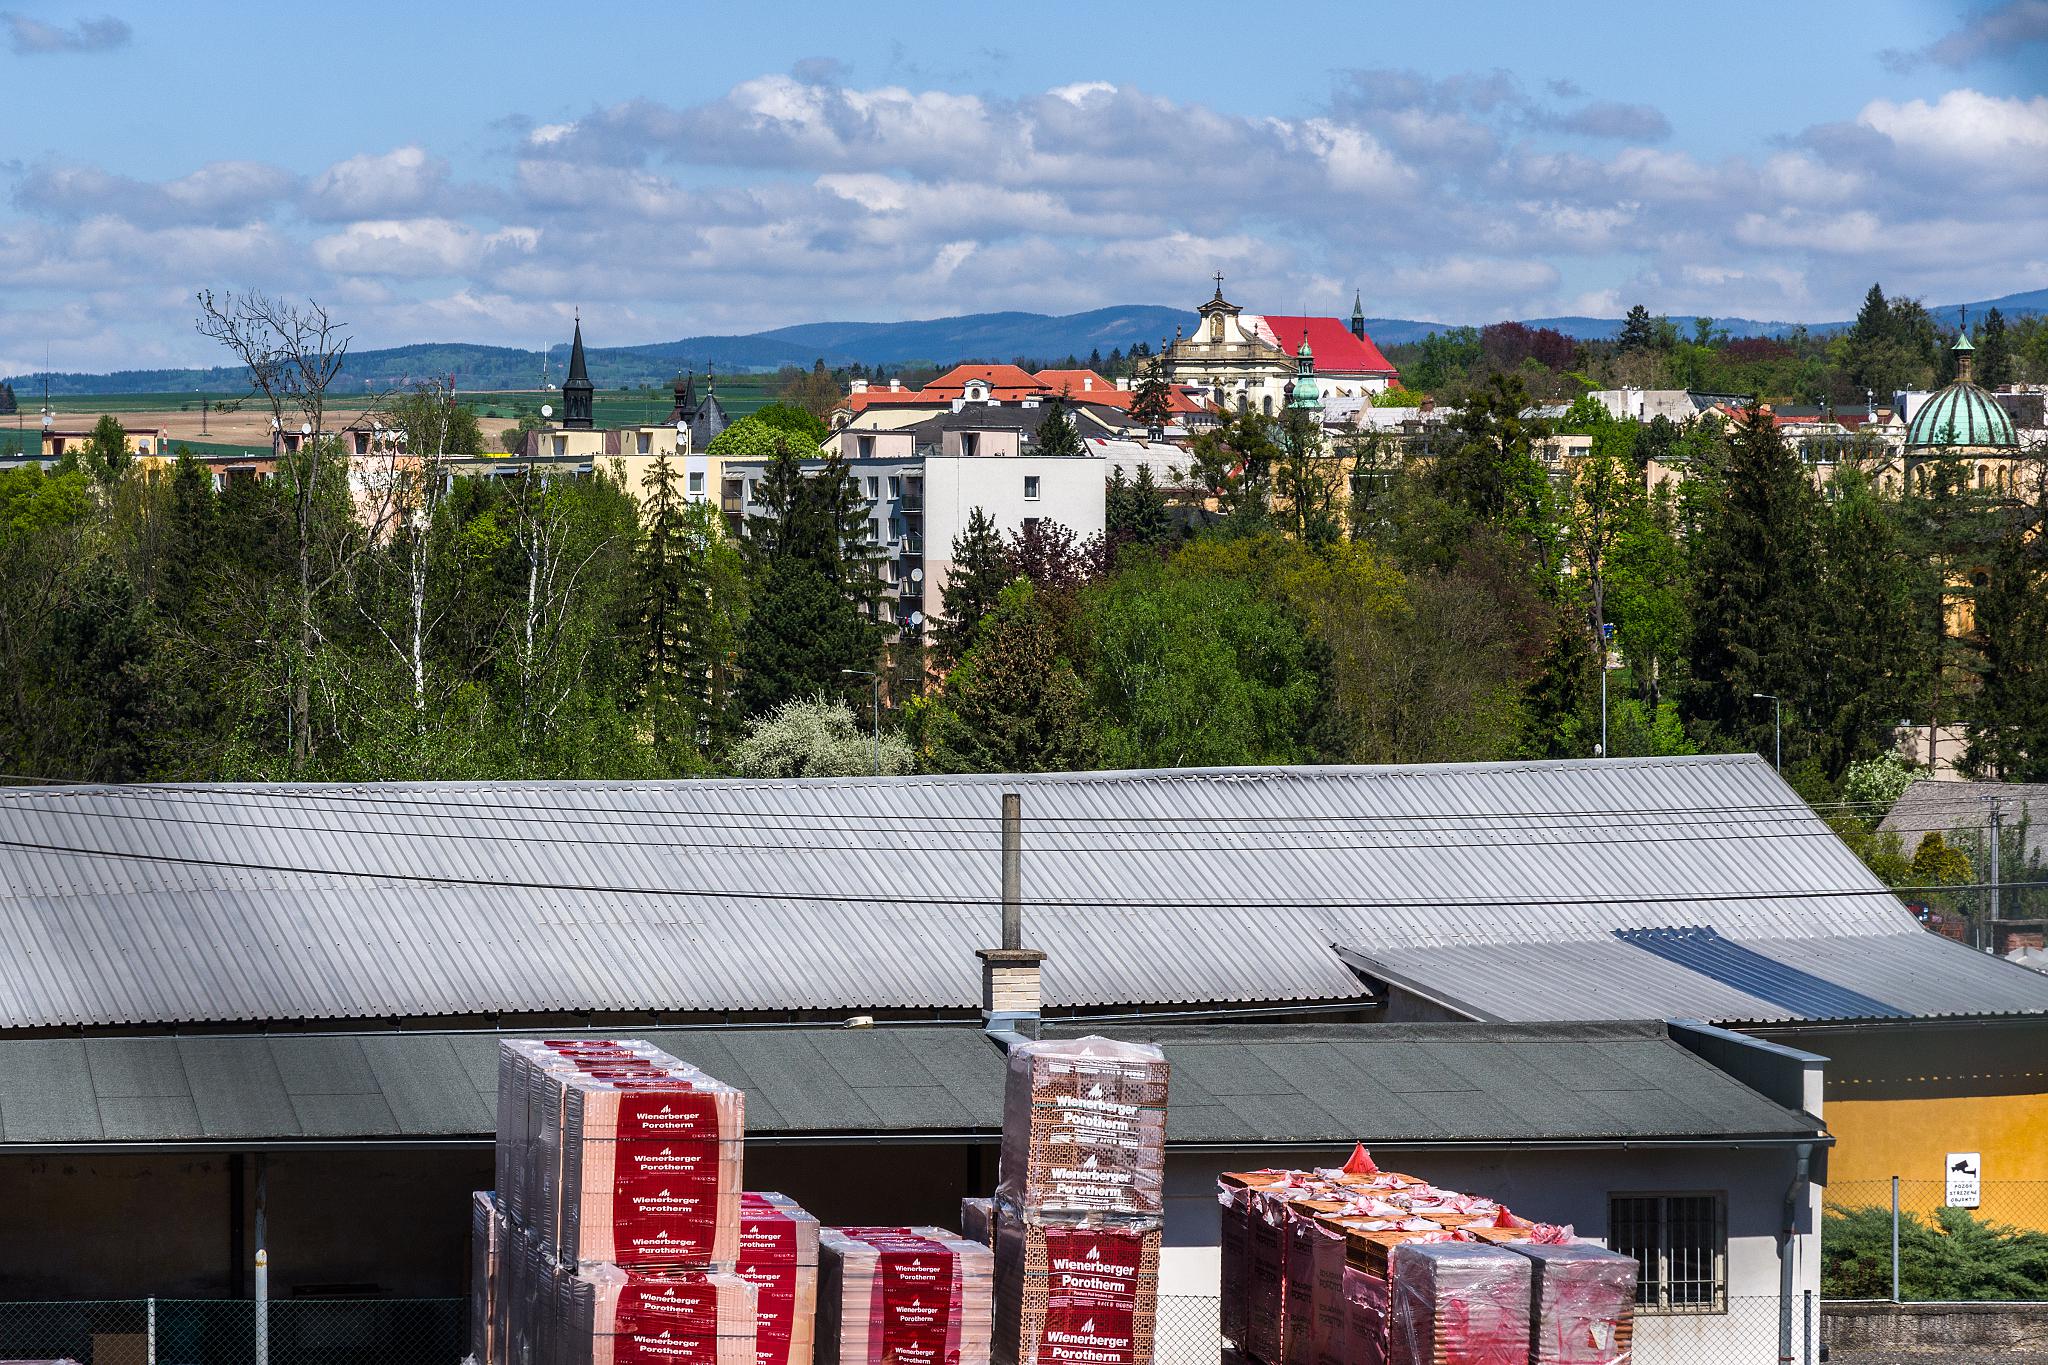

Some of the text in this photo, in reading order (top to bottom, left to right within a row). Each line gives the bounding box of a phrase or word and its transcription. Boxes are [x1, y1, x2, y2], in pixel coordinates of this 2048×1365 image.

[1056, 1096, 1138, 1116] Wienerberger
[636, 1112, 700, 1121] Wienerberger
[1063, 1111, 1129, 1131] Porotherm
[634, 1155, 701, 1163] Wienerberger
[1051, 1167, 1132, 1182] Wienerberger
[1056, 1183, 1122, 1197] Porotherm
[632, 1196, 700, 1205] Wienerberger
[639, 1205, 692, 1213] Porotherm
[632, 1238, 697, 1247] Wienerberger
[638, 1247, 689, 1255] Porotherm
[895, 1265, 941, 1273] Wienerberger
[1053, 1258, 1135, 1277] Wienerberger
[900, 1273, 936, 1281] Porotherm
[1062, 1274, 1125, 1292] Porotherm
[640, 1292, 700, 1305] Wienerberger
[644, 1302, 694, 1313] Porotherm
[895, 1306, 939, 1315] Wienerberger
[633, 1335, 700, 1348] Wienerberger
[1047, 1331, 1129, 1348] Wienerberger
[639, 1345, 693, 1356] Porotherm
[895, 1346, 935, 1357] Wienerberger
[1052, 1347, 1121, 1362] Porotherm
[898, 1355, 931, 1365] Porotherm
